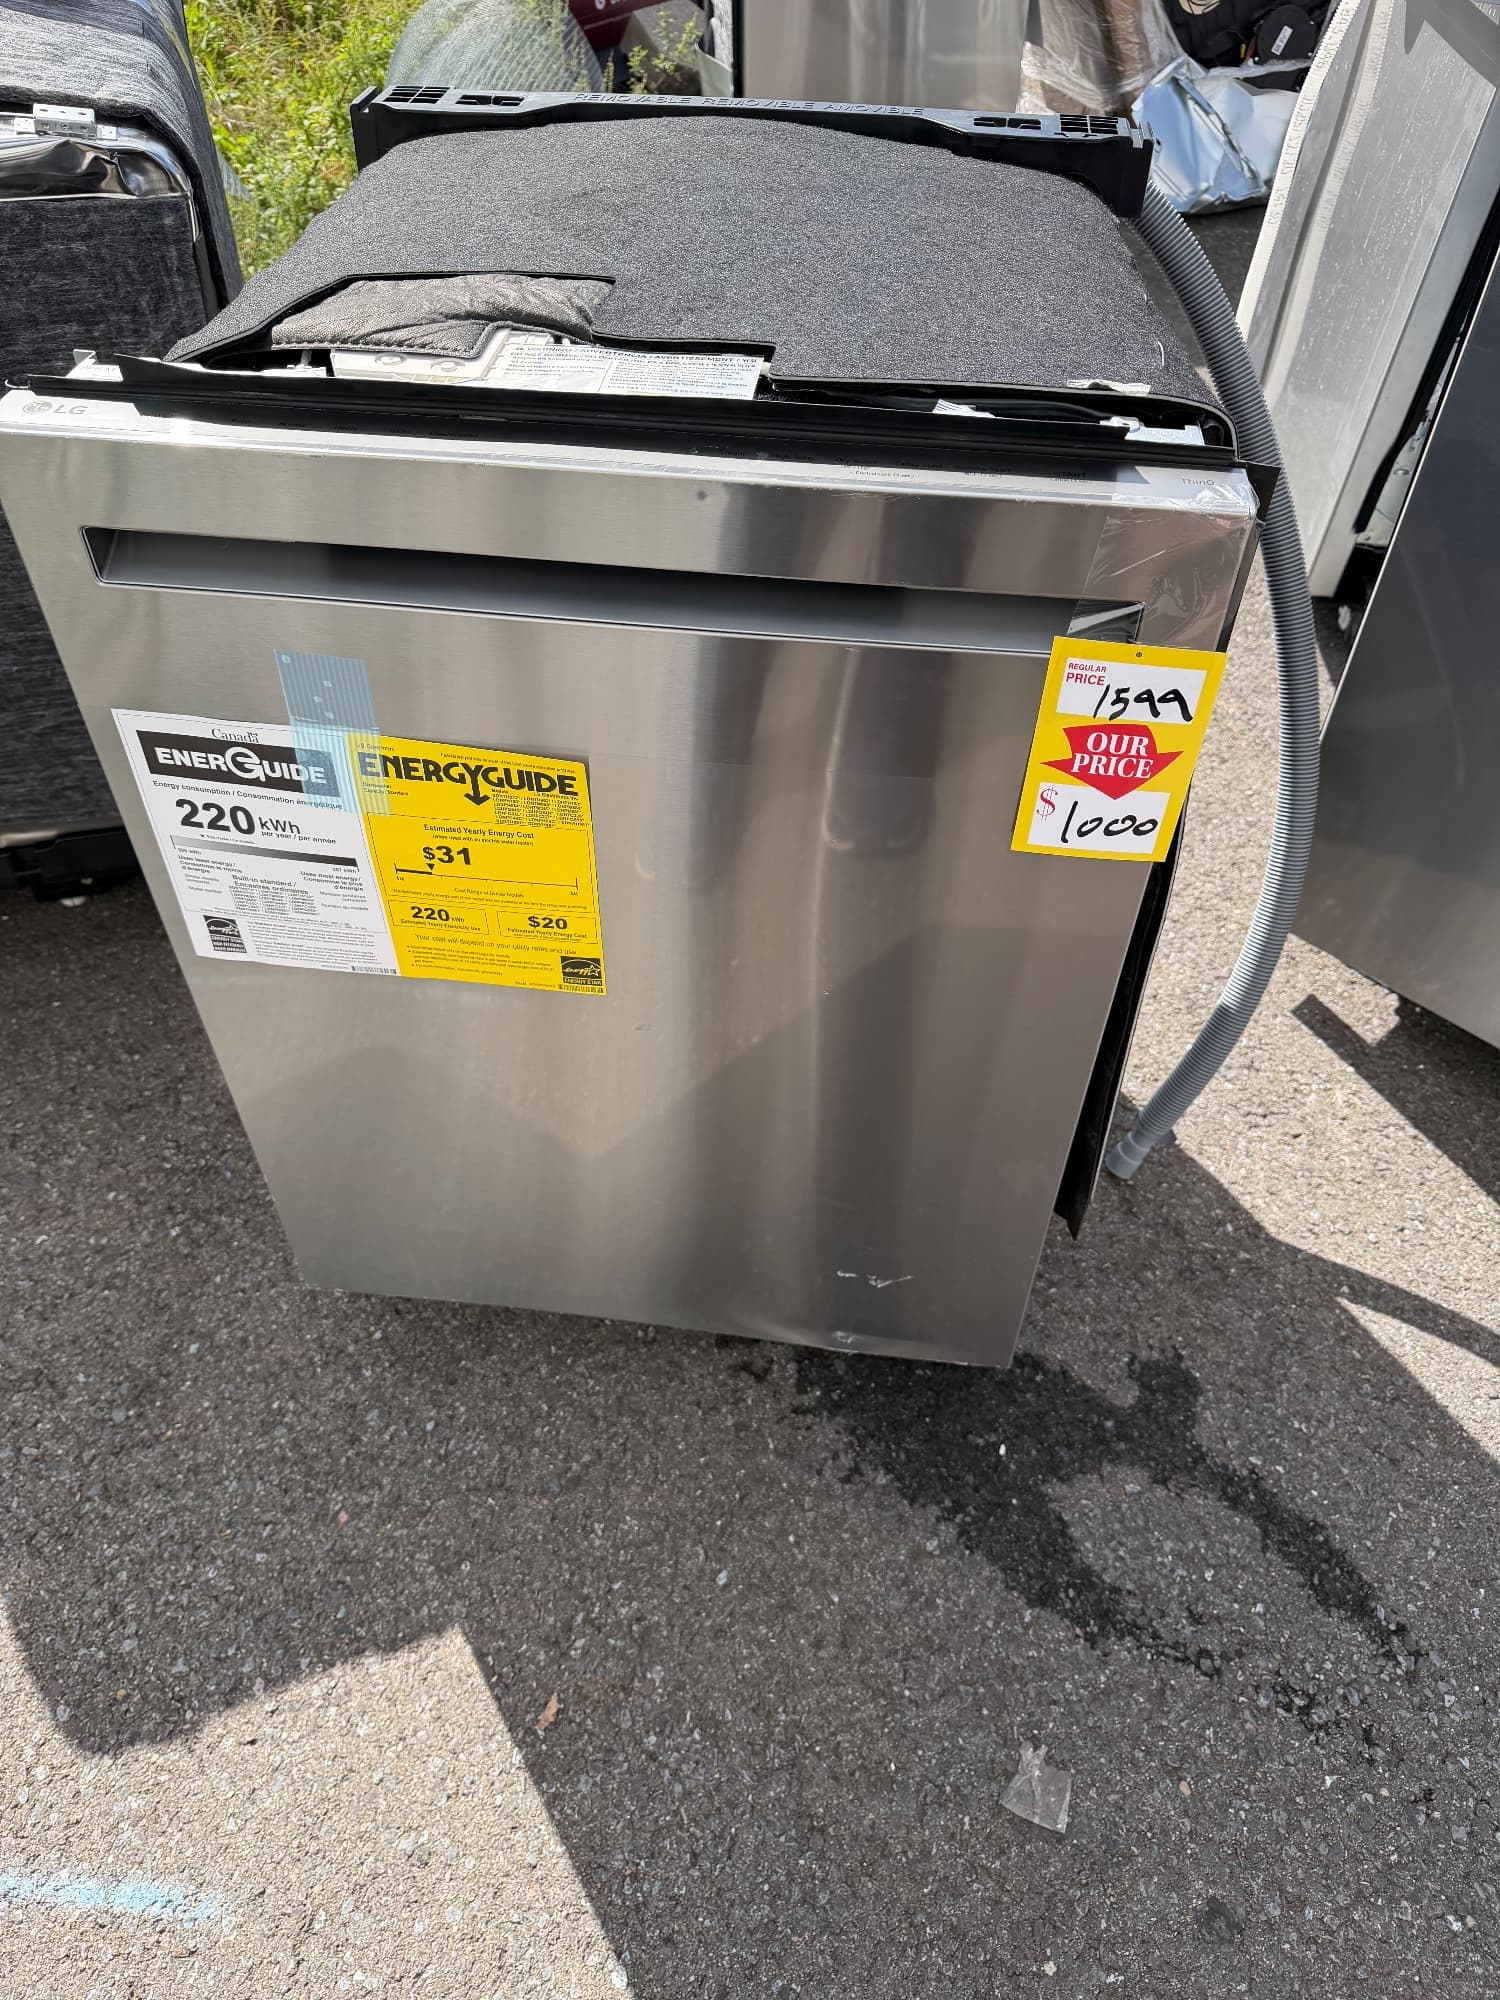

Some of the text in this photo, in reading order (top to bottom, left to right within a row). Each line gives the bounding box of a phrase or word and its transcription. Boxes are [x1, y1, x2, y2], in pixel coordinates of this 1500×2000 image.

[575, 92, 924, 116] REMOVABLE REMOVIBLE AMOVIBLE
[53, 404, 88, 415] LG
[1066, 672, 1106, 686] PRICE
[1068, 663, 1107, 673] REGULAR
[1093, 684, 1193, 722] 1599
[211, 728, 260, 743] Canada
[1086, 732, 1149, 757] OUR
[358, 752, 578, 797] ENERGYGUIDE
[1070, 753, 1154, 779] PRICE
[153, 780, 180, 790] Energy
[182, 785, 231, 797] consumption
[237, 790, 294, 804] Consommation
[175, 798, 301, 835] 220 kWh
[1036, 786, 1158, 844] $ 1000
[424, 824, 535, 839] Estimated Yearly Energy Cost
[422, 845, 471, 866] $31
[411, 905, 450, 922] 220
[528, 916, 568, 930] $20
